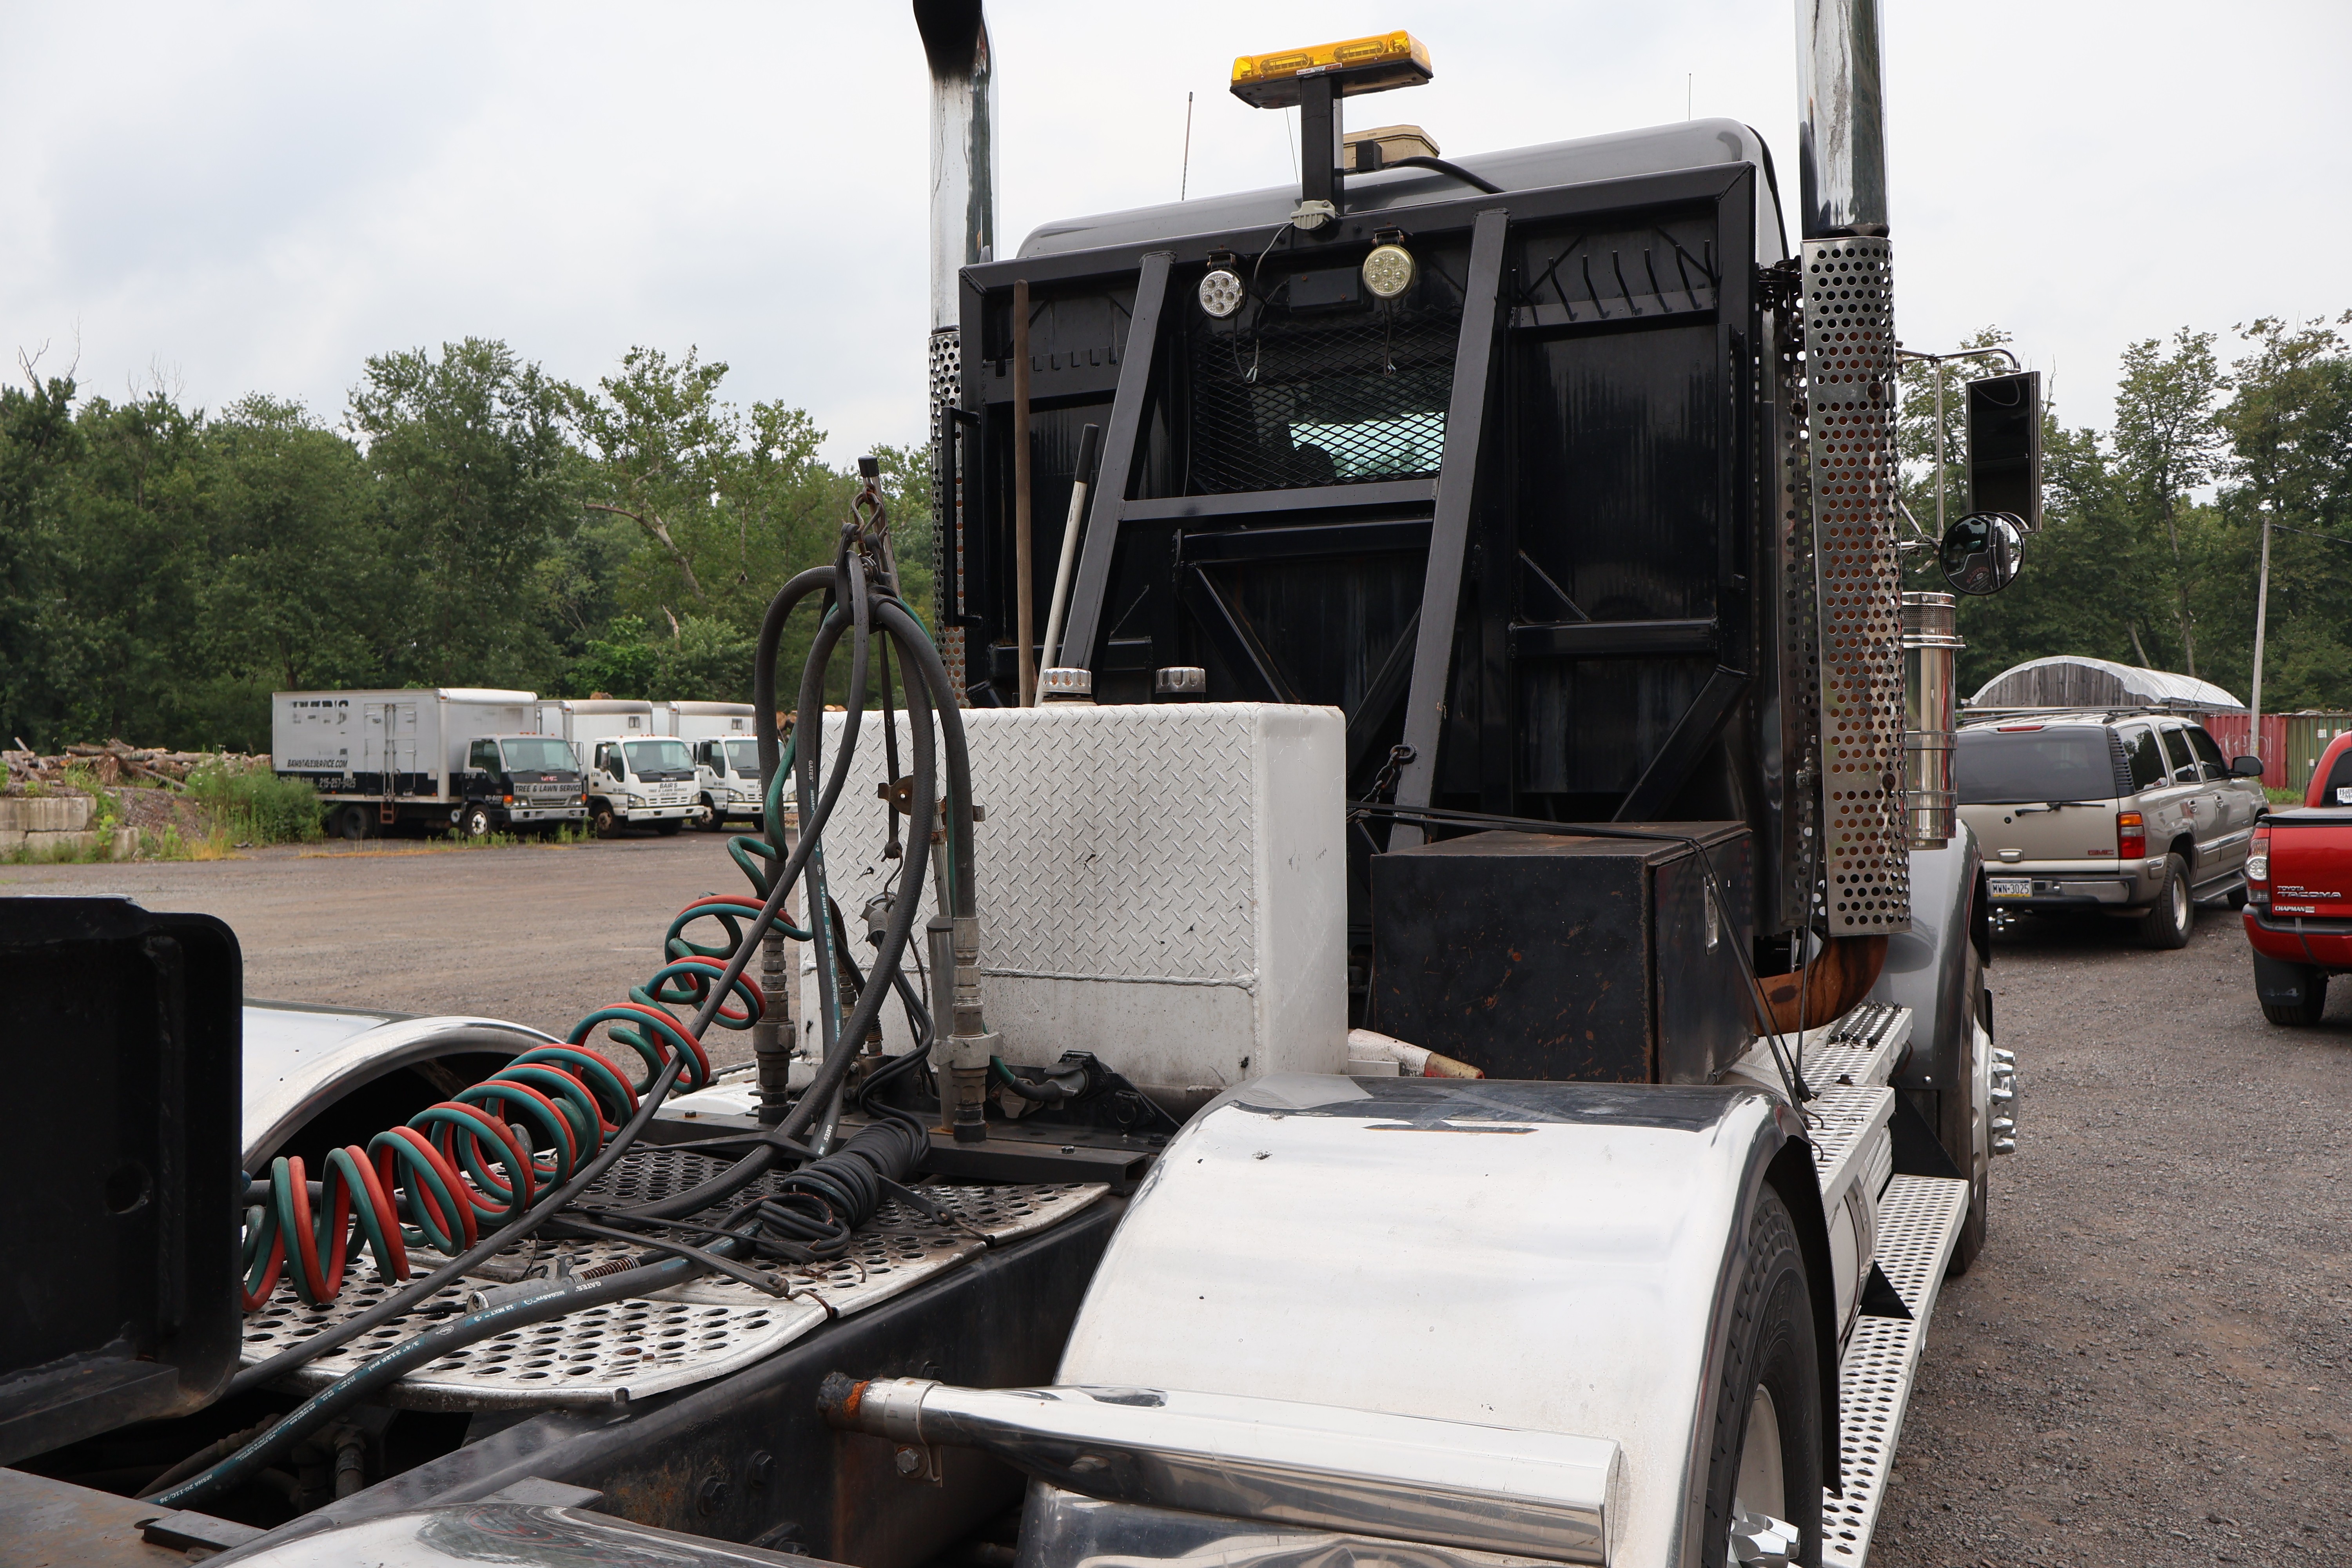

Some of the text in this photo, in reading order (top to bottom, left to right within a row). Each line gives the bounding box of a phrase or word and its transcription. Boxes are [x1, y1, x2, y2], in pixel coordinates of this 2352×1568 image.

[380, 1349, 401, 1363] 3125
[367, 1360, 381, 1372] psi
[194, 1473, 213, 1487] MSHA
